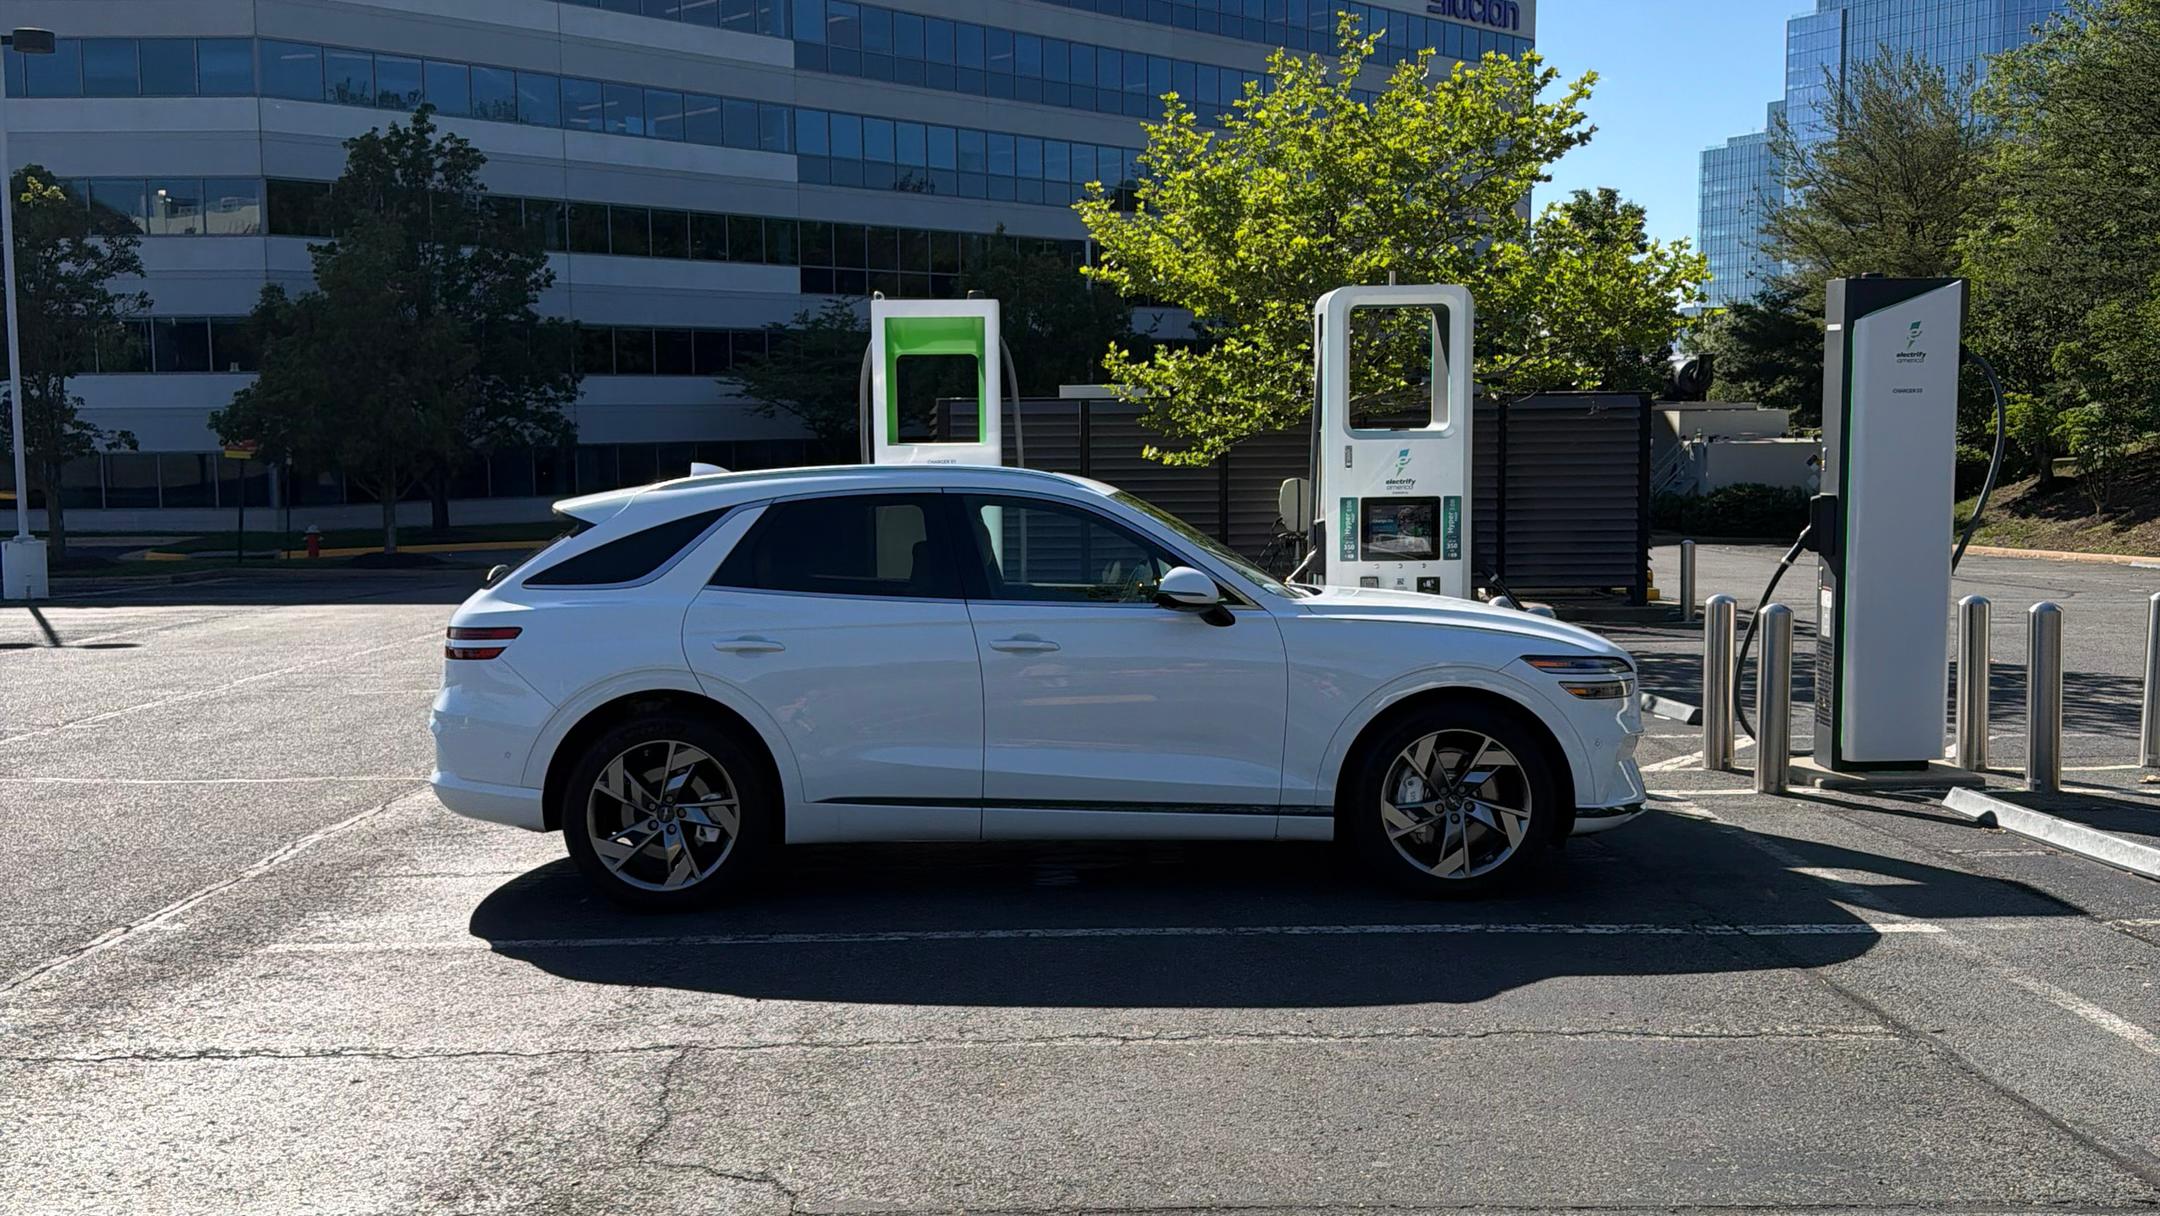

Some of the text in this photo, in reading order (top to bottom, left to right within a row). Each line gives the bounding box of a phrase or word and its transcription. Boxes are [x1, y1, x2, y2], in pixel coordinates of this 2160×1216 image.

[1385, 479, 1416, 487] electrify
[1344, 512, 1353, 535] Hyper
[1447, 512, 1455, 534] Hyper
